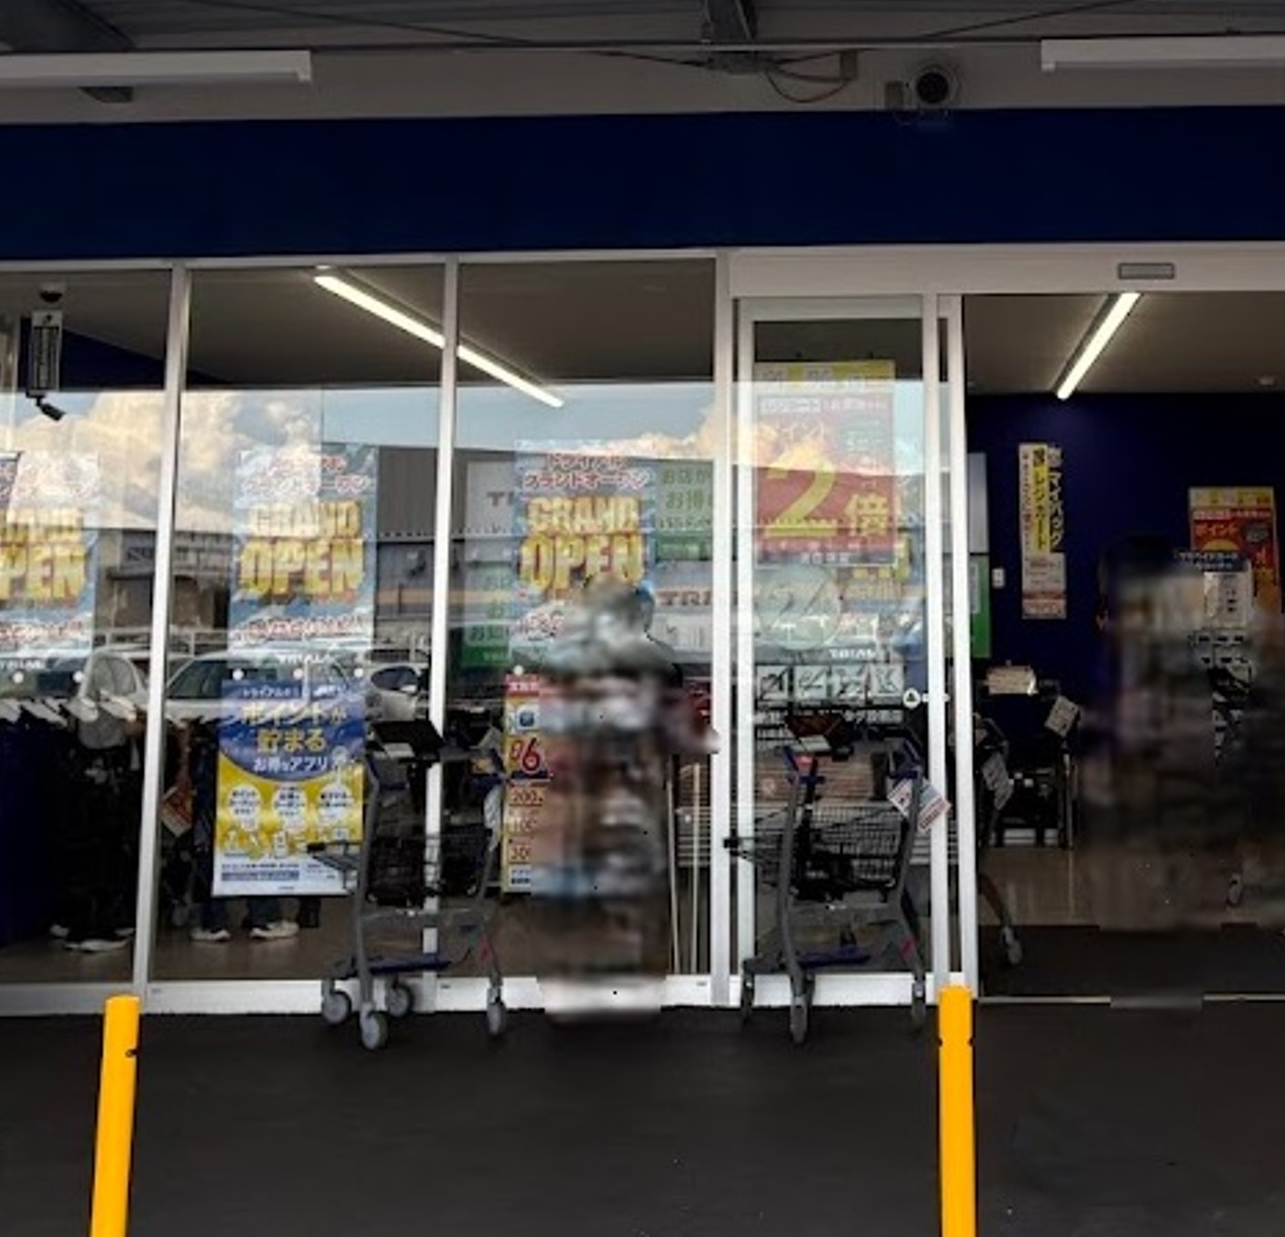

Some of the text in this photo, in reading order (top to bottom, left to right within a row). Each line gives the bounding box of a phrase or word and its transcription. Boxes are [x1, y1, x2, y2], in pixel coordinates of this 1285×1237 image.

[238, 538, 366, 598] OPEN
[517, 495, 646, 596] GRAND OPEN
